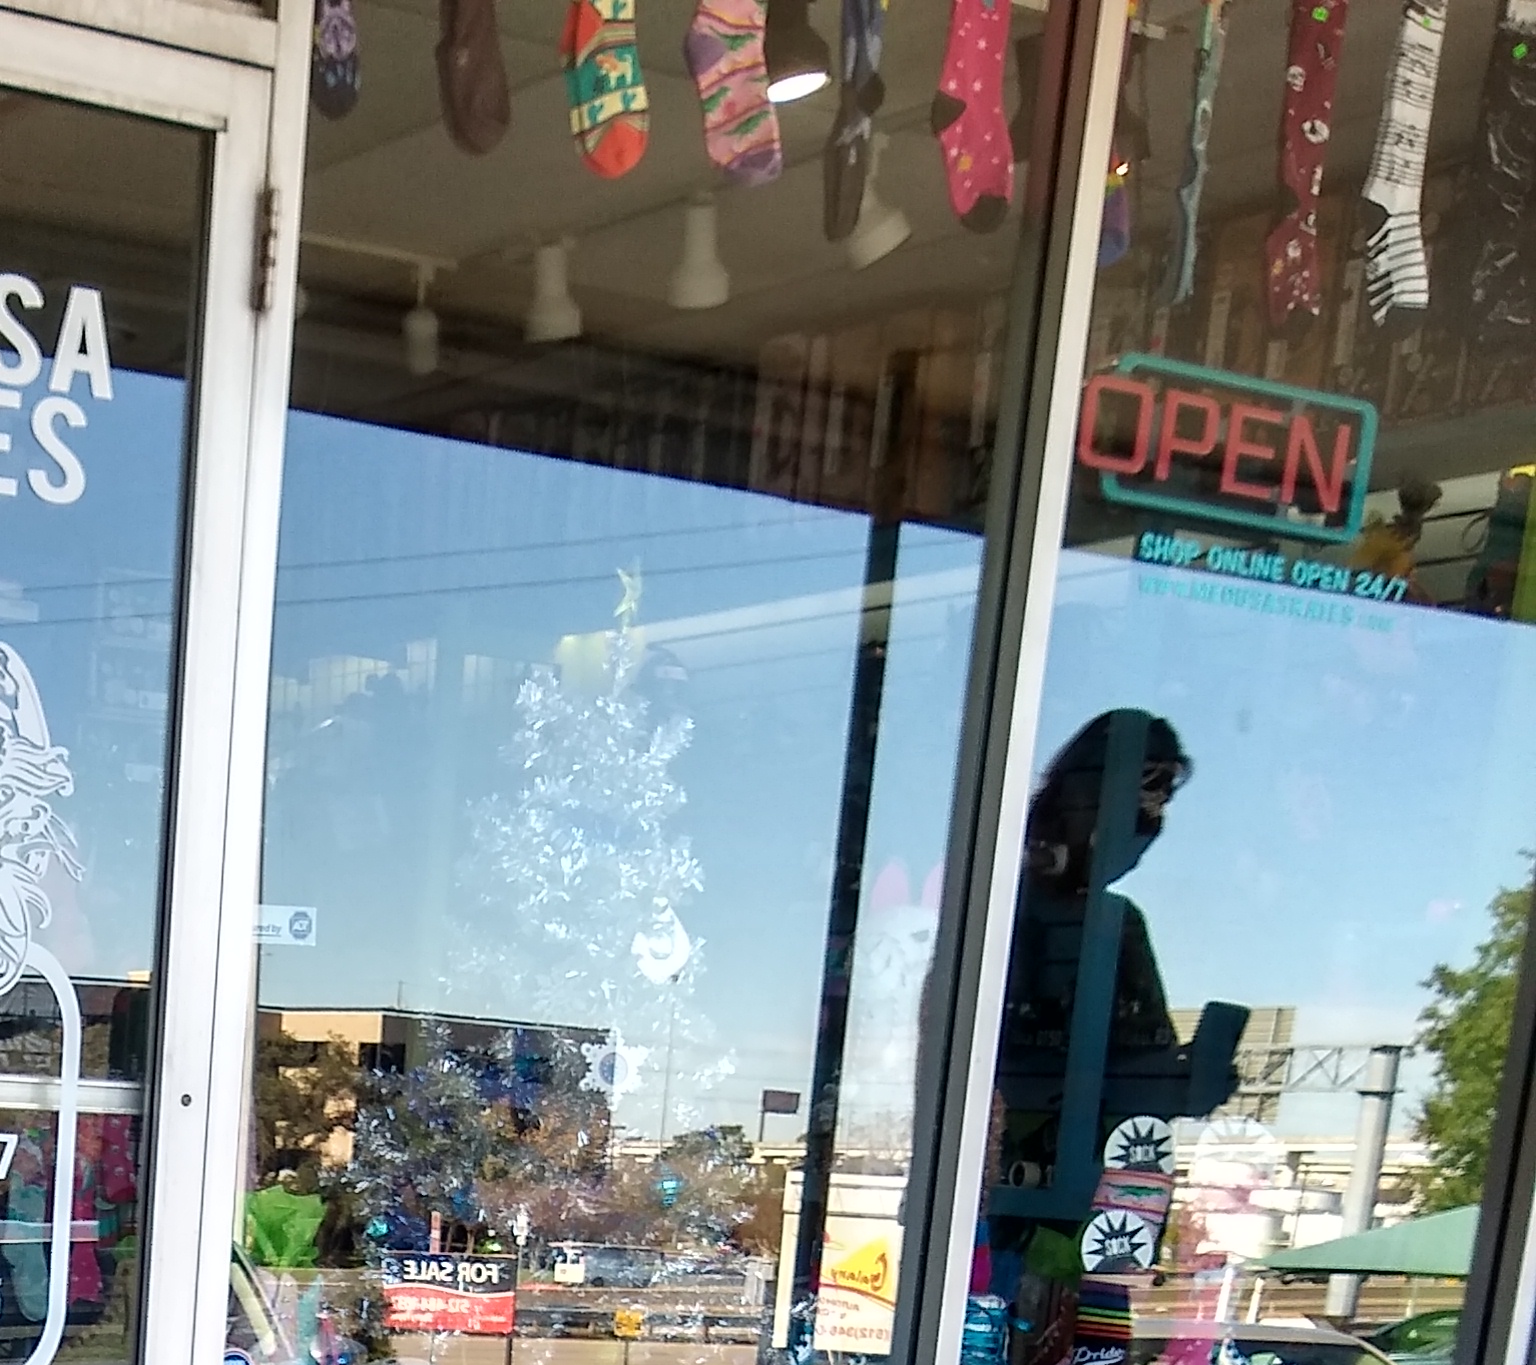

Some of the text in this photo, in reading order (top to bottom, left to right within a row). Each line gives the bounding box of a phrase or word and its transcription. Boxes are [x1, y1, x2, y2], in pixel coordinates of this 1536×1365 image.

[1076, 374, 1352, 513] OPEN
[1138, 531, 1408, 602] SHOP ONLINE OPEN 24/7
[1105, 1237, 1131, 1256] SOCK
